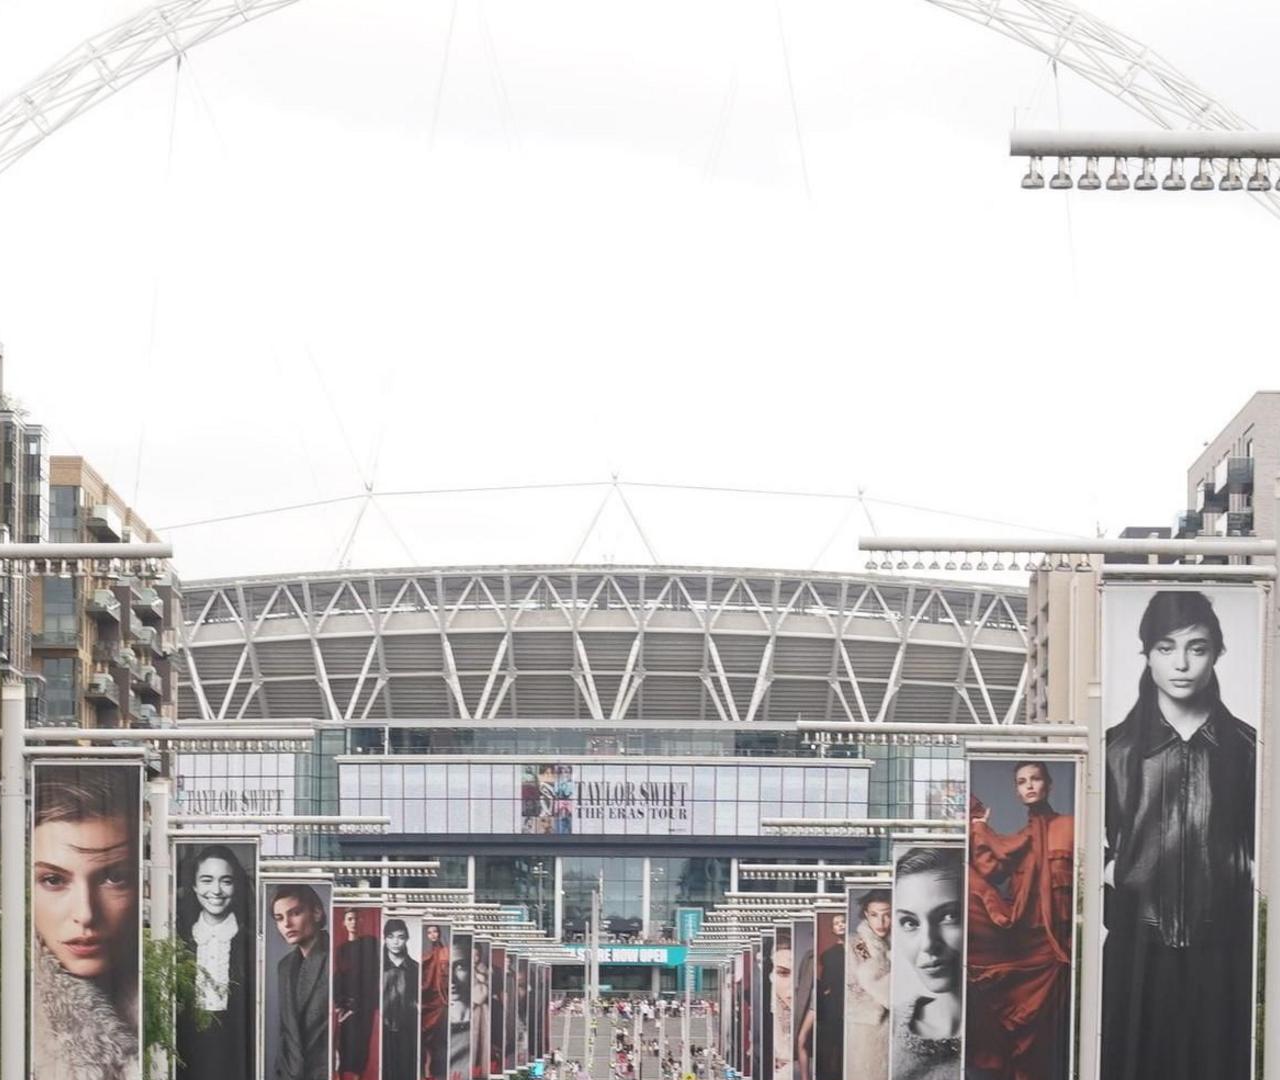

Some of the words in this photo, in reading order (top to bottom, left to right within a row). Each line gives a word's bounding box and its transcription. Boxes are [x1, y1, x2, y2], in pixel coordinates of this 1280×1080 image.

[186, 789, 237, 812] TAYLOR
[241, 789, 284, 812] SWIFT
[575, 781, 636, 806] TAYLOR
[640, 781, 688, 806] SWIFT
[576, 807, 604, 819] THE
[609, 807, 644, 819] ERAS
[649, 808, 687, 820] TOUR
